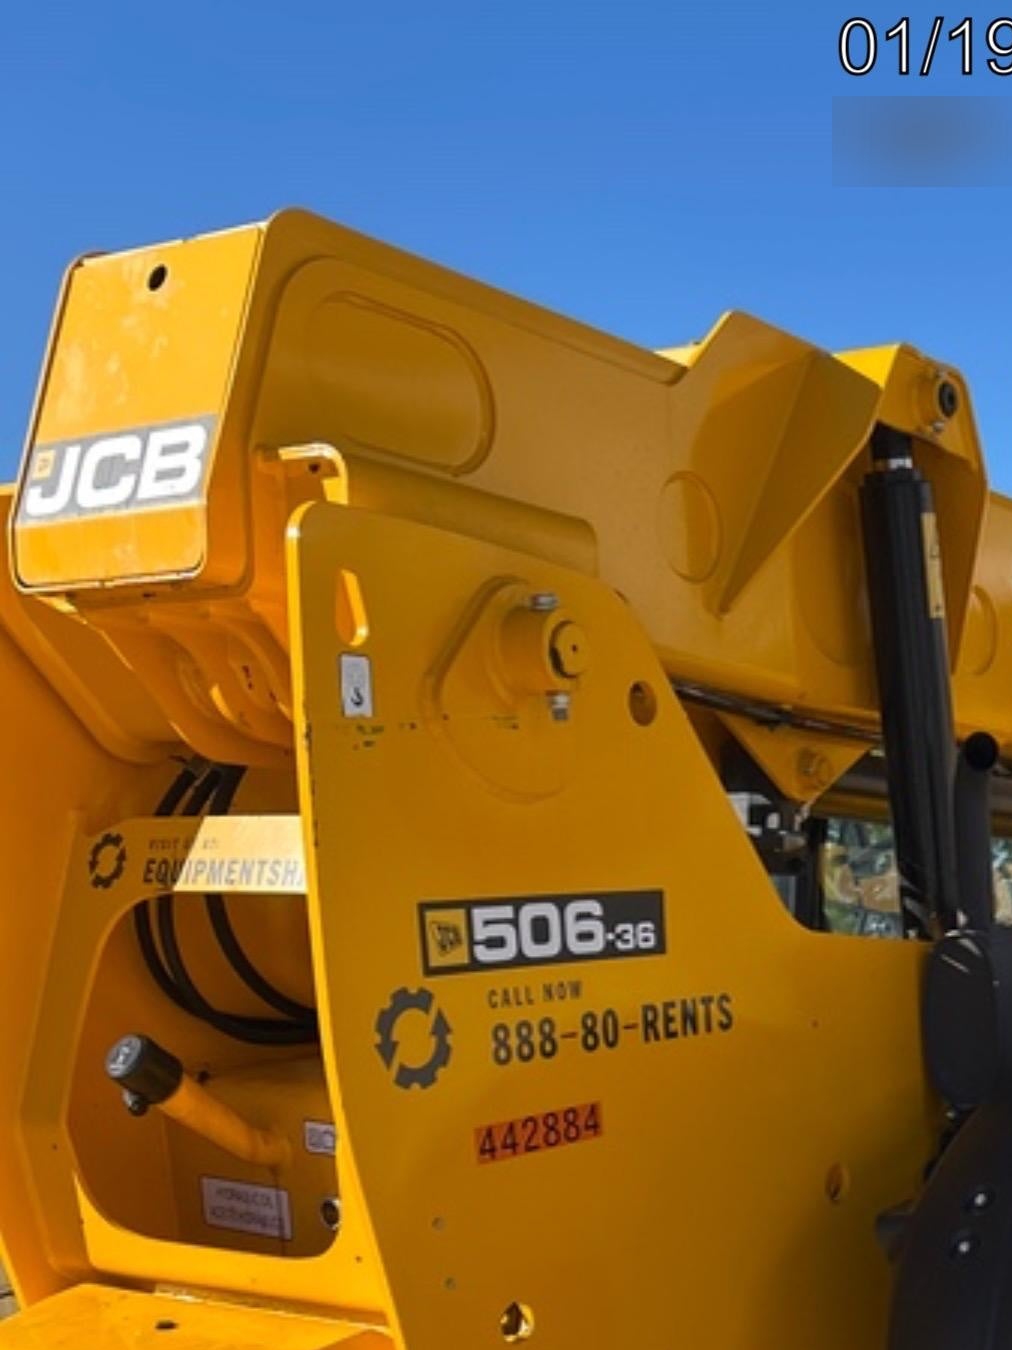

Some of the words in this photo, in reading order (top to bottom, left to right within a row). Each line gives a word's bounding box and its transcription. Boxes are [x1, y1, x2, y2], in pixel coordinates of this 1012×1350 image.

[25, 425, 207, 516] JCB
[471, 900, 655, 962] 506-36
[488, 986, 534, 1009] CALL
[543, 981, 582, 1001] NOW
[491, 993, 733, 1066] 888-80-RENTS
[478, 1103, 601, 1161] 442884
